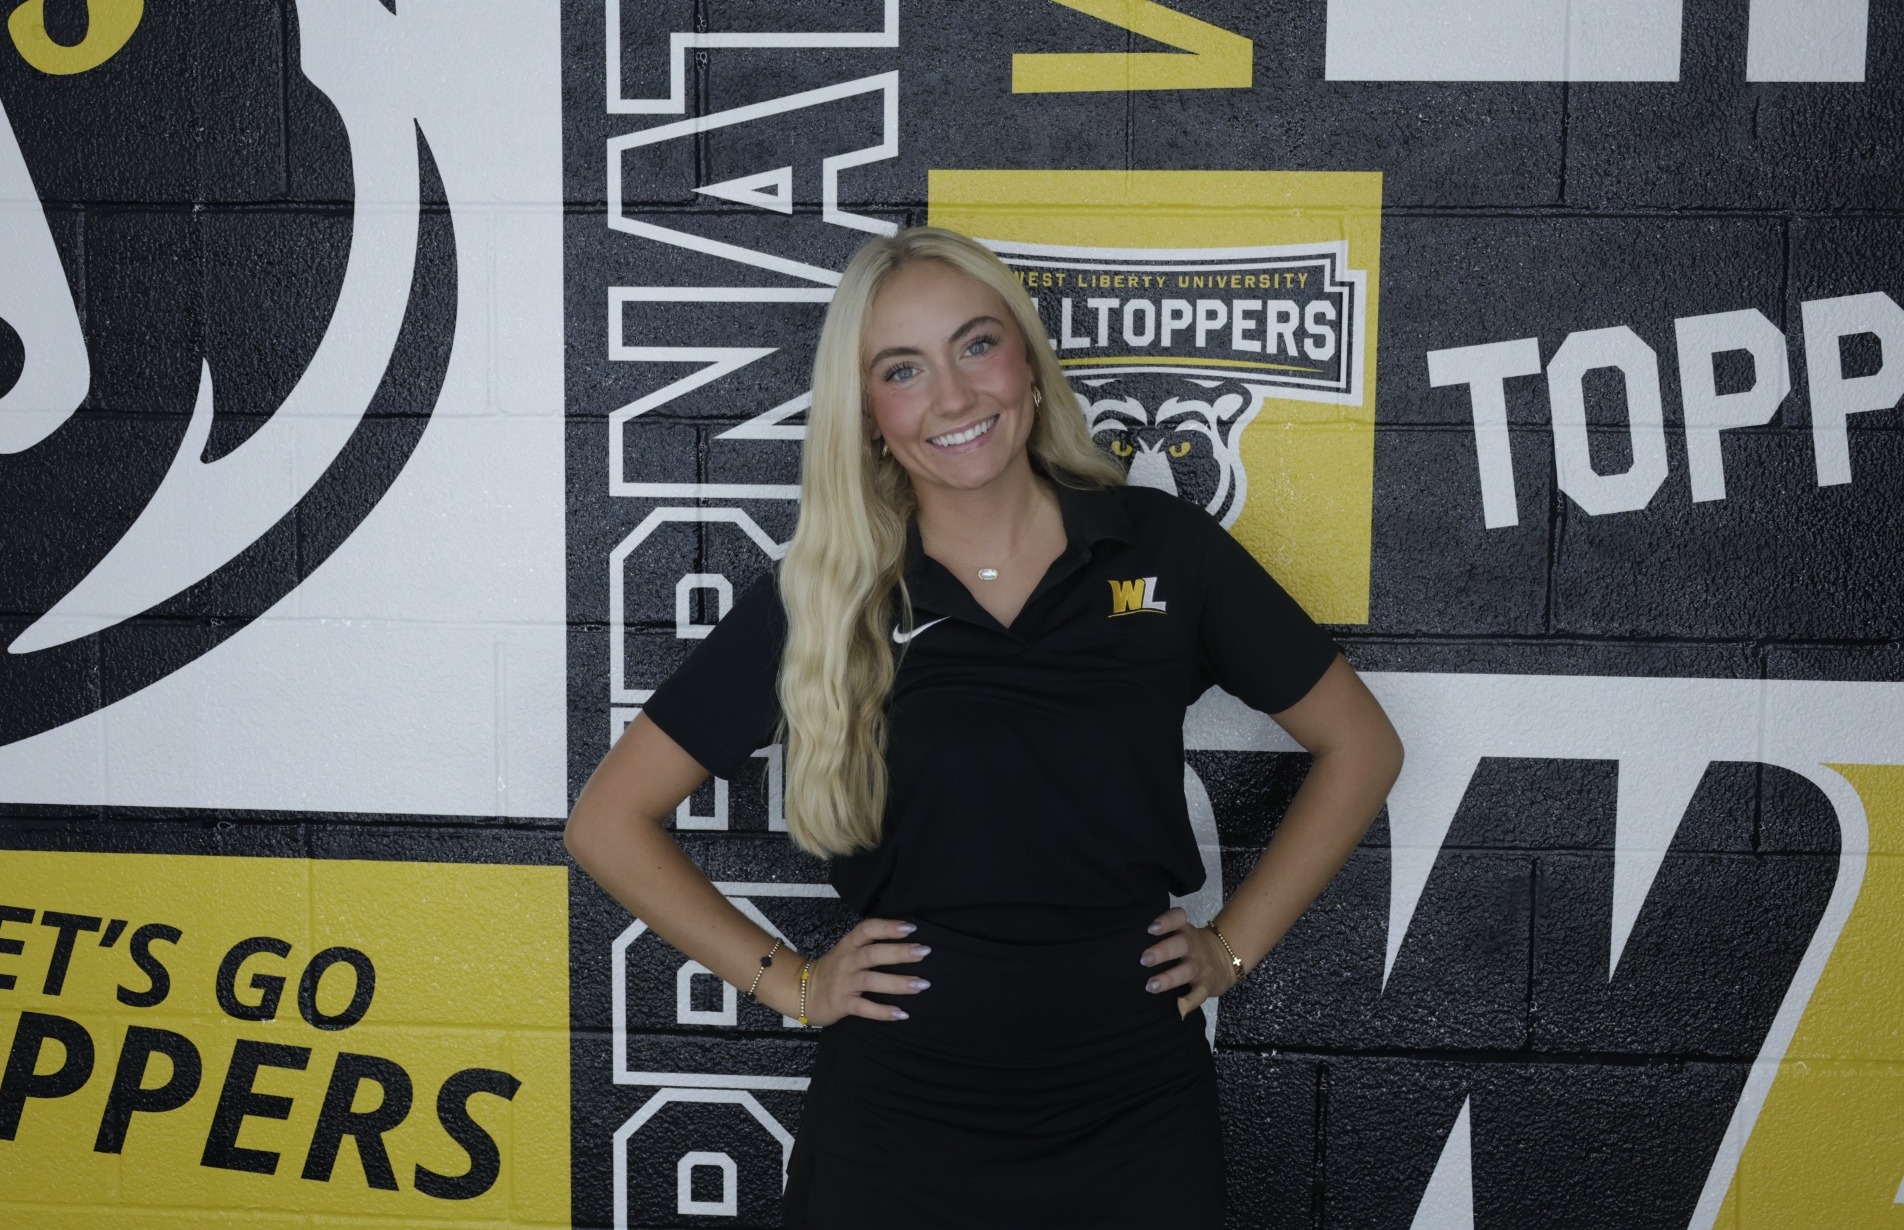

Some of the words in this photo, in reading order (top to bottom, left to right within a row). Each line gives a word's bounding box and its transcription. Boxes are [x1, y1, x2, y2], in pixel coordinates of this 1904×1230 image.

[1078, 274, 1166, 288] LIBERTY
[1178, 273, 1309, 288] UNIVERSITY
[1426, 290, 1904, 530] TOPP
[1107, 576, 1167, 613] WL
[215, 936, 377, 1032] GO
[0, 1010, 522, 1201] PPERS
